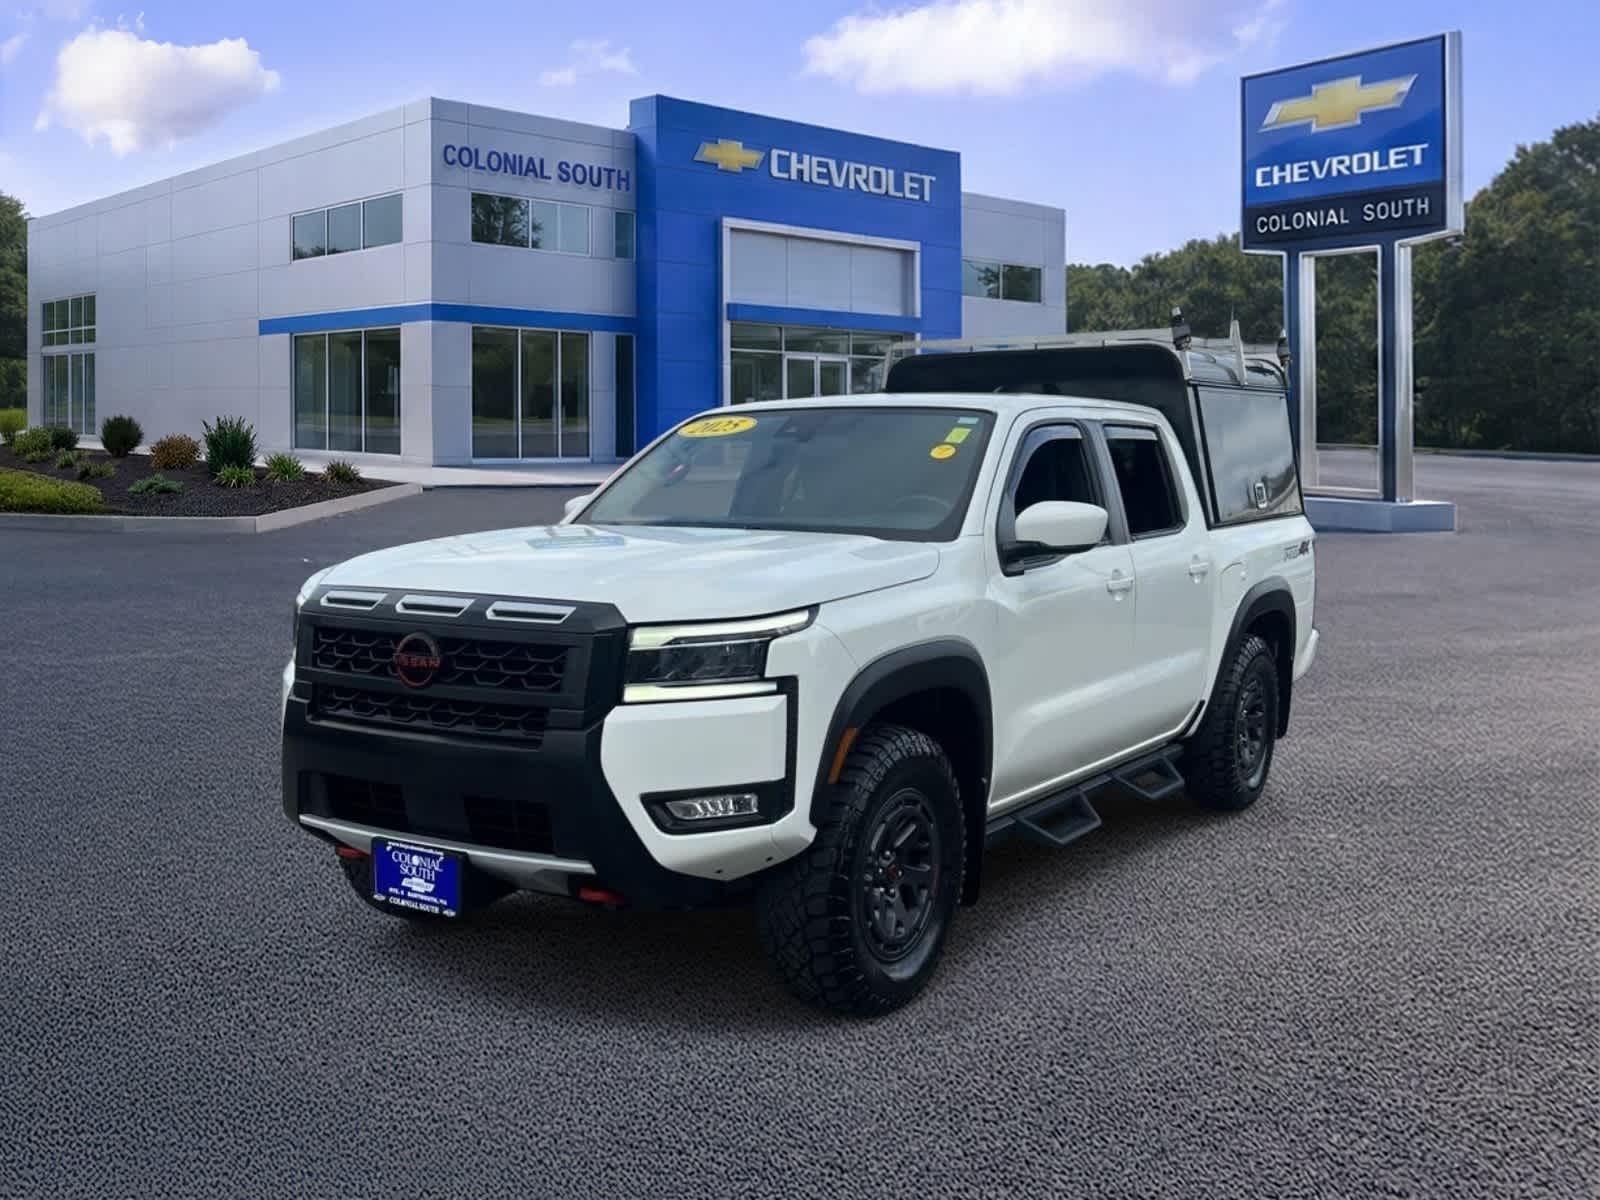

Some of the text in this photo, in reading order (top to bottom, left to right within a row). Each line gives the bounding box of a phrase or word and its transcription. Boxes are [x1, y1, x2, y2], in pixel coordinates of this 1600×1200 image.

[443, 144, 631, 191] COLONIAL SOUTH
[770, 148, 936, 202] CHEVROLET
[1255, 143, 1429, 188] CHEVROLET
[1256, 197, 1430, 234] COLONIAL SOUTH
[391, 850, 443, 872] COLONIAL
[400, 863, 436, 881] SOUTH
